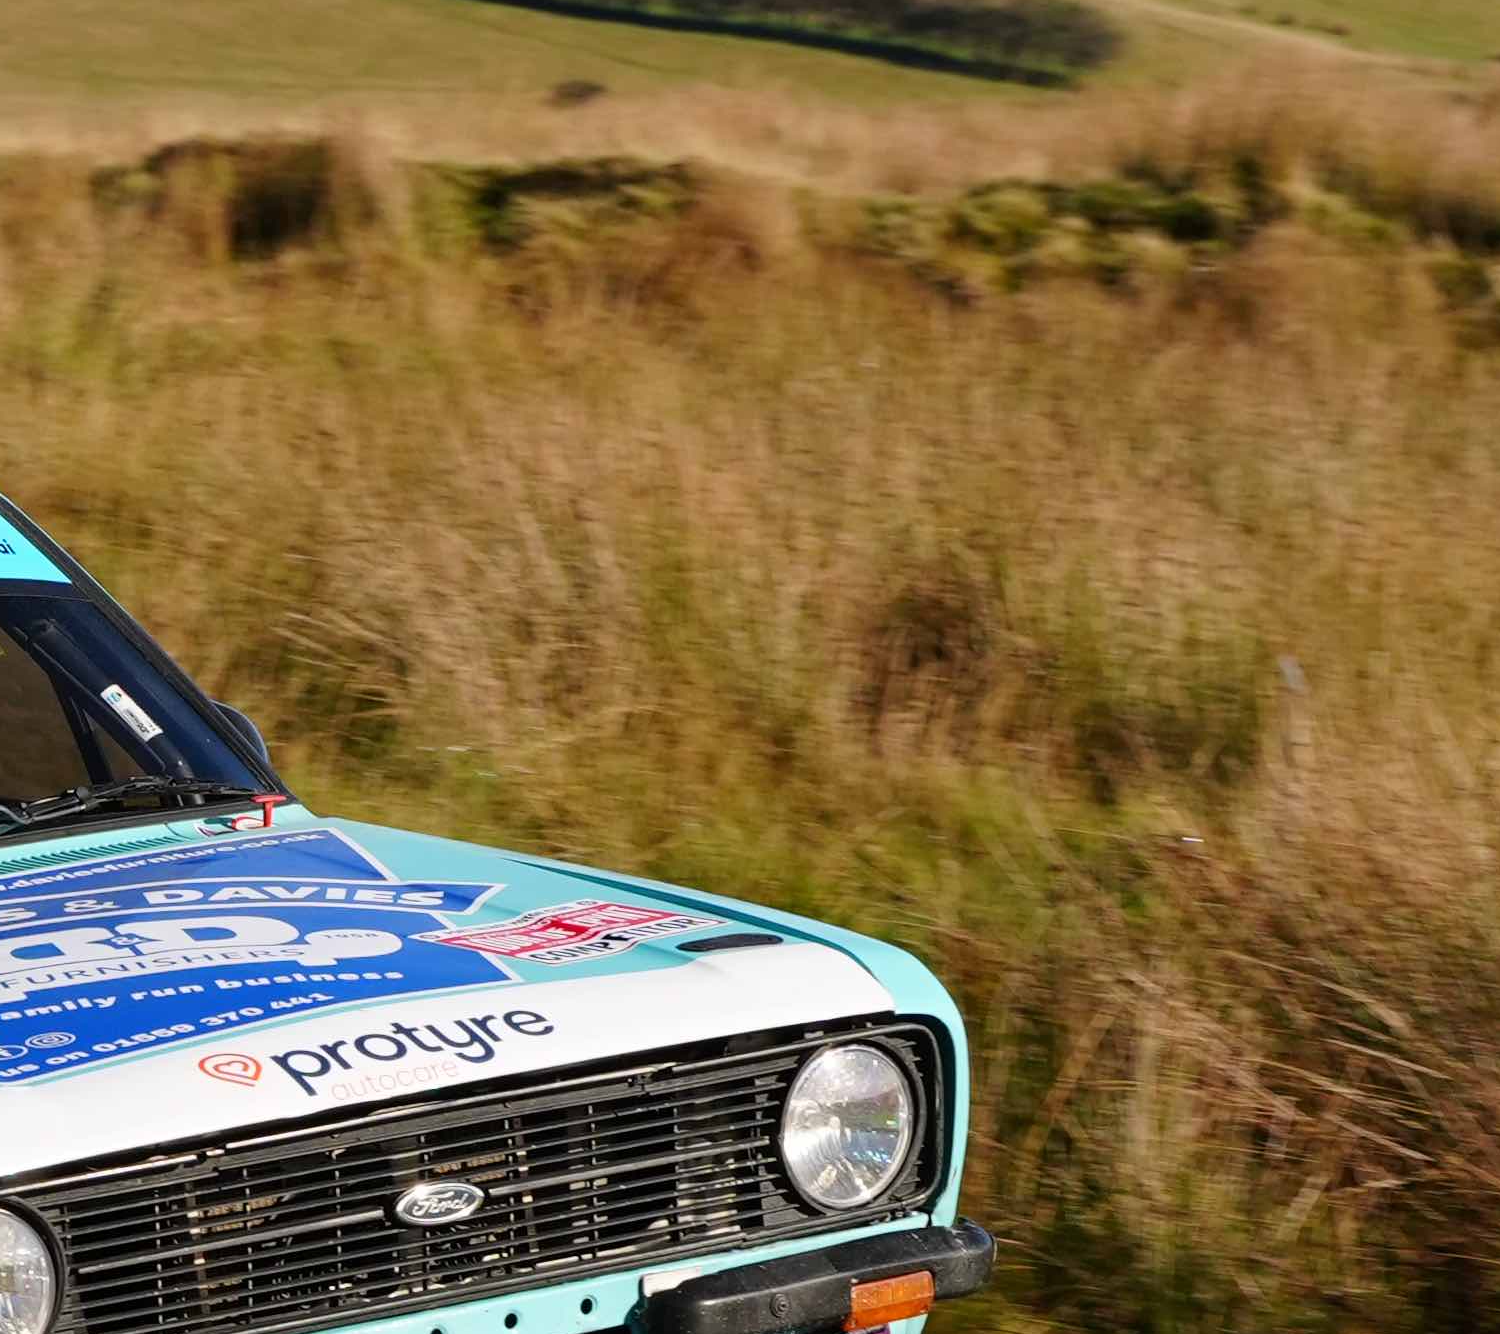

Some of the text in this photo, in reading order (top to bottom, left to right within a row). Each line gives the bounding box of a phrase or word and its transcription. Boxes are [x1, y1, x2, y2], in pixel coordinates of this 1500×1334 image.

[63, 896, 120, 915] &
[142, 882, 446, 906] DAVIES
[530, 917, 703, 961] COMPETITOR
[0, 947, 305, 990] FURNISHERS
[130, 982, 203, 1002] run
[215, 967, 404, 991] business
[45, 1050, 90, 1065] on
[206, 1004, 264, 1028] 370
[267, 992, 335, 1011] 441
[268, 1009, 554, 1097] protyre
[331, 1055, 459, 1102] autocare
[411, 1191, 469, 1216] Ford
